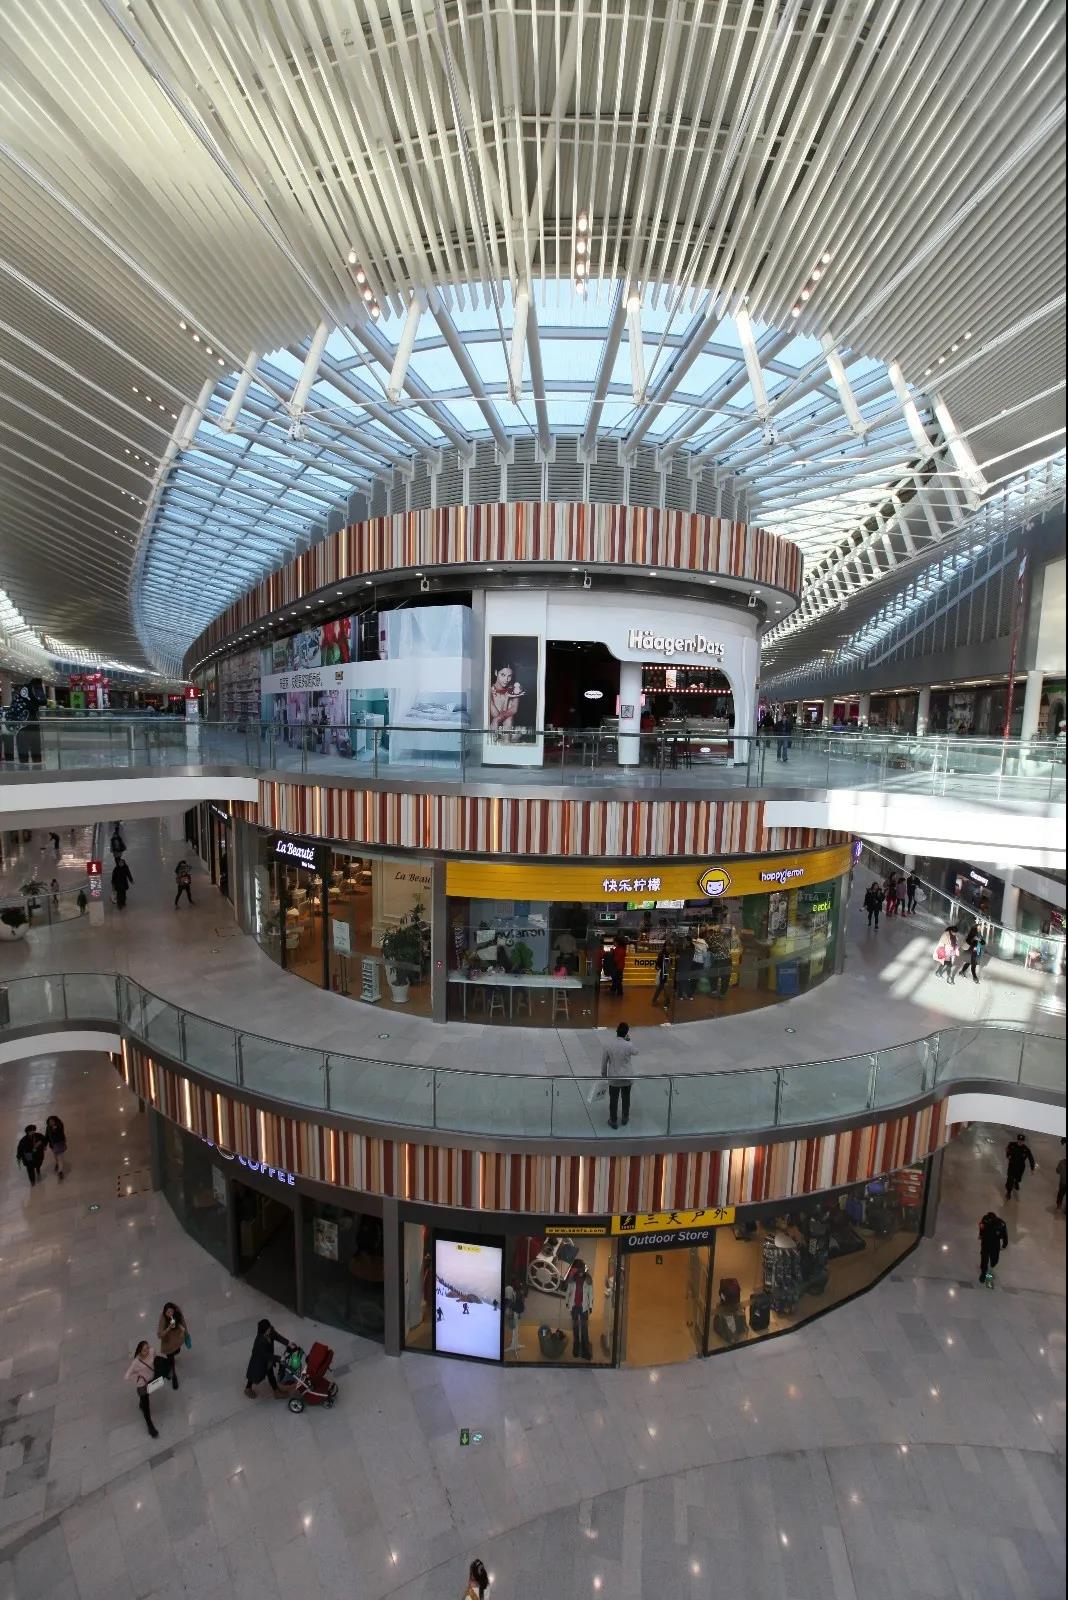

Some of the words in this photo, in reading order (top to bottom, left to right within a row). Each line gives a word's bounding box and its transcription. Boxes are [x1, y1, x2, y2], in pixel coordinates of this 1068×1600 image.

[628, 629, 725, 656] Häagen-Dazs
[276, 840, 287, 854] La
[287, 842, 315, 860] Beauté
[603, 877, 661, 893] 快乐柠檬
[628, 1233, 676, 1247] Outdoor
[678, 1229, 709, 1242] Store
